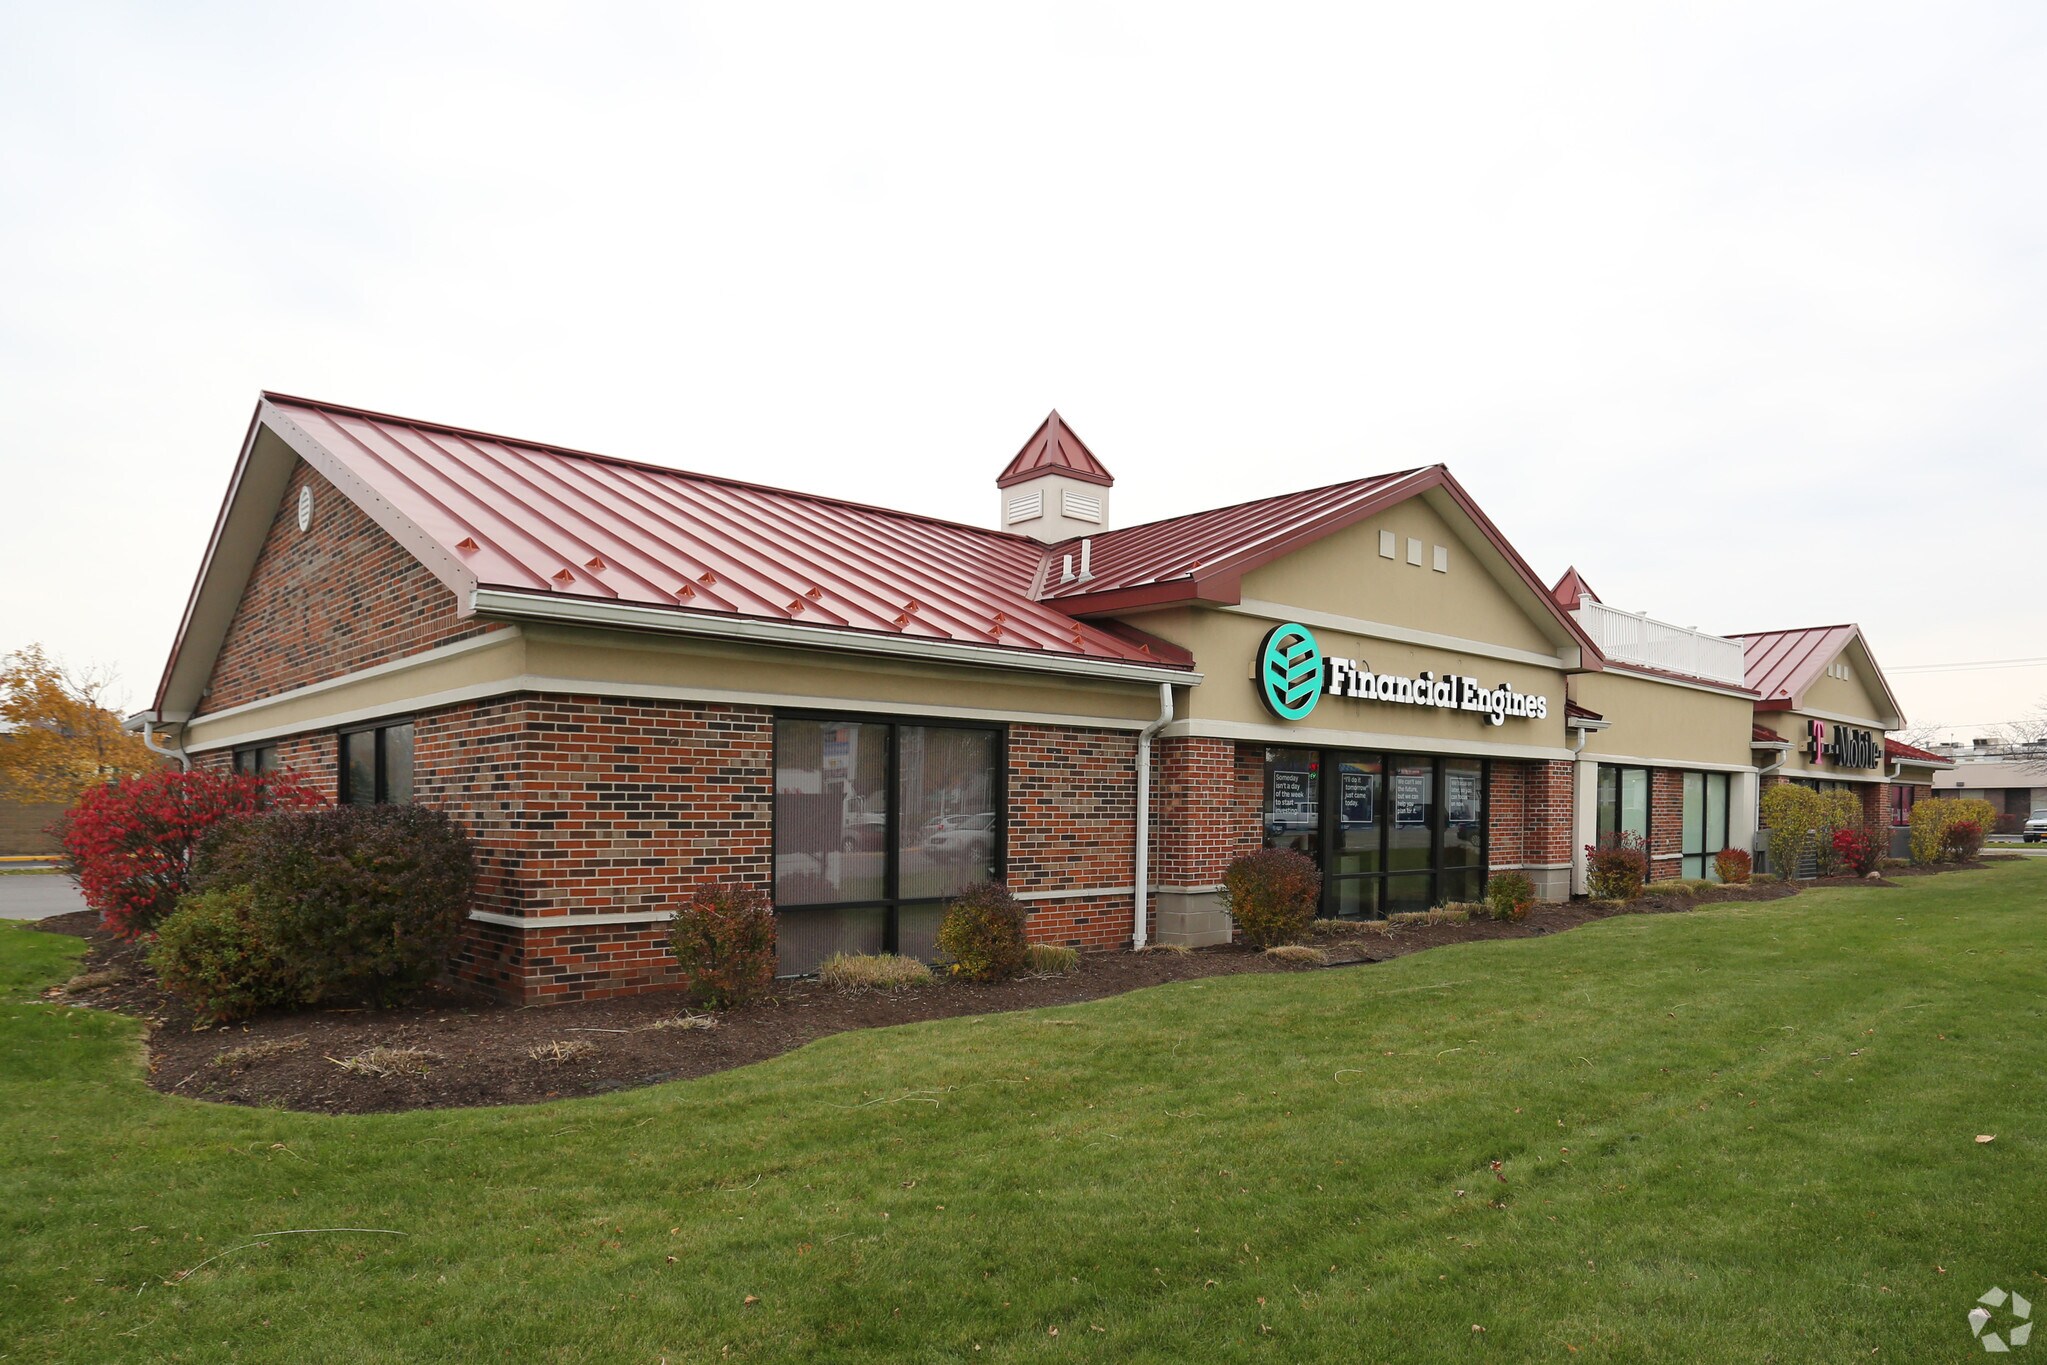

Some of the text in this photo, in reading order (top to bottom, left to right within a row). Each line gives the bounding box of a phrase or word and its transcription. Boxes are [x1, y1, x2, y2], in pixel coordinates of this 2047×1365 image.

[1328, 656, 1548, 727] Financial Engines
[1275, 774, 1299, 782] Someday
[1275, 782, 1286, 790] isn't
[1291, 783, 1300, 791] day
[1281, 790, 1290, 798] the
[1275, 798, 1281, 806] to
